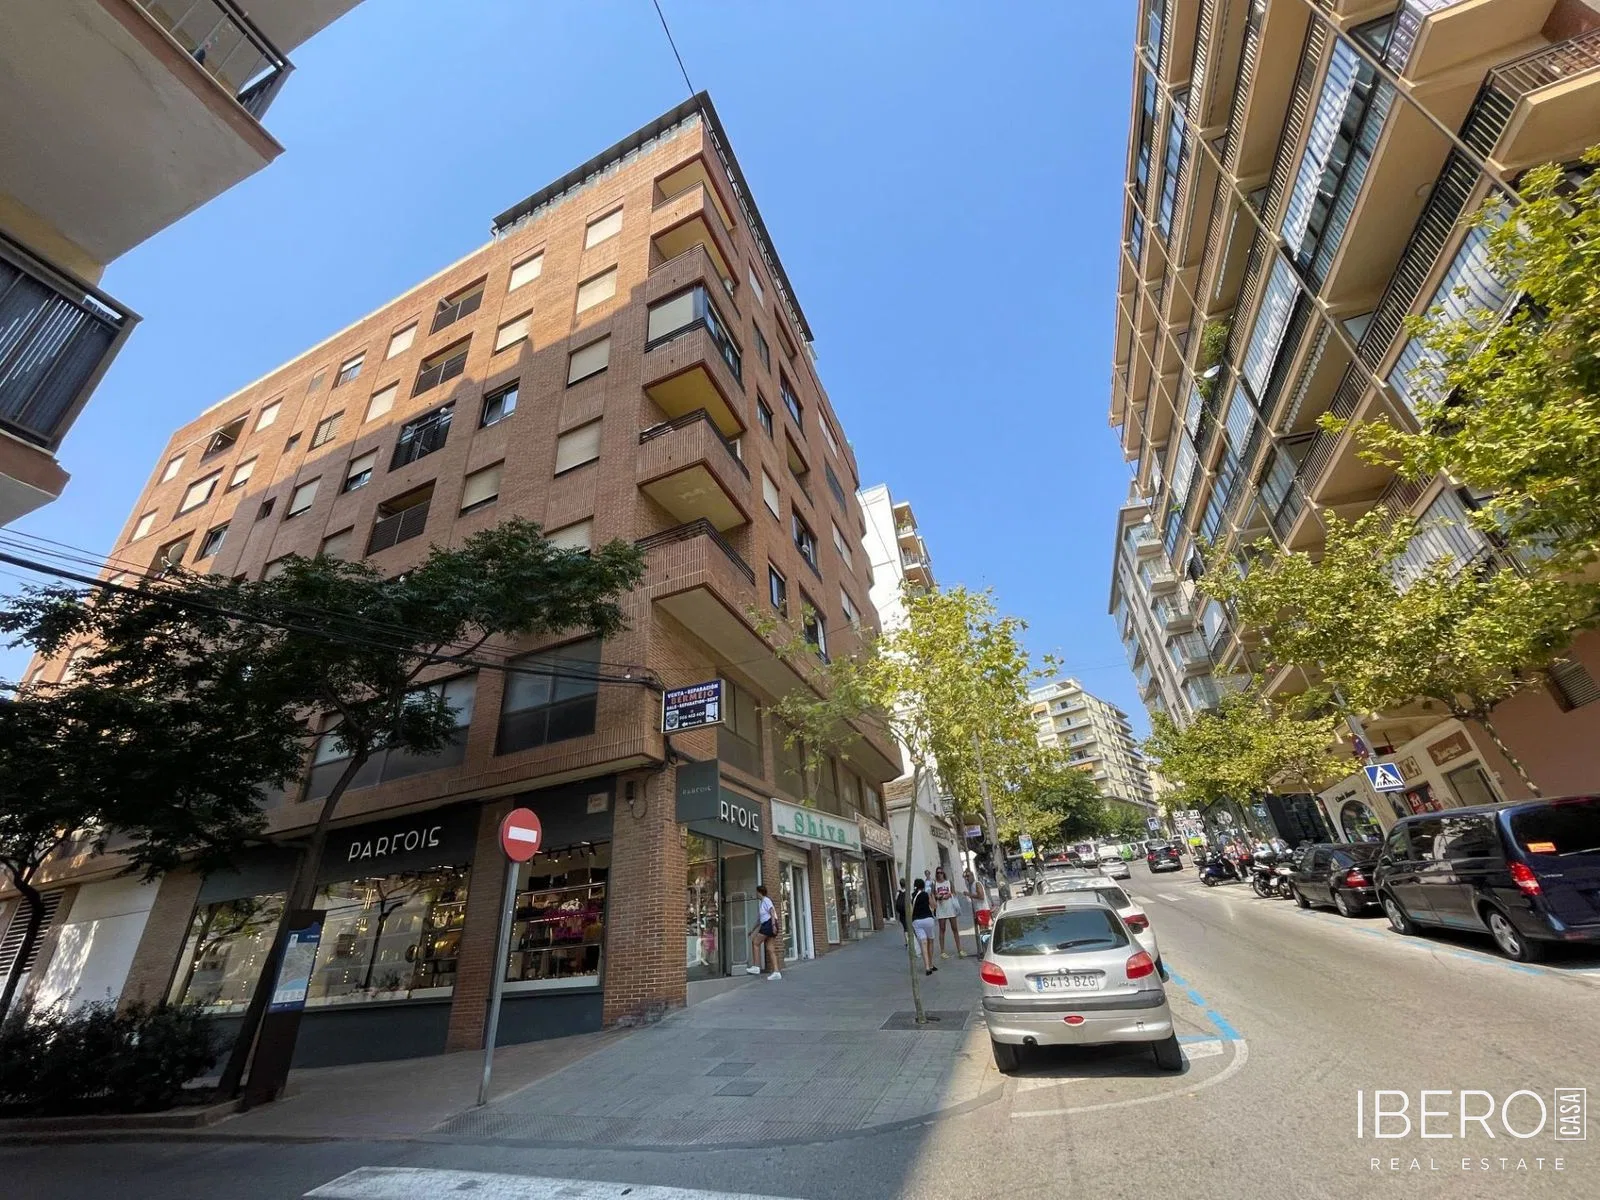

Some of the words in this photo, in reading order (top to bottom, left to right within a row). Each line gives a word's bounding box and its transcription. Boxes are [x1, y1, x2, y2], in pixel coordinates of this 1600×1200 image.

[671, 690, 714, 704] BERMEJO
[720, 800, 760, 832] RFOIS
[794, 812, 846, 844] Shiva
[348, 826, 442, 862] PARFOIS
[1042, 975, 1071, 988] 6413
[1075, 975, 1096, 987] BZG
